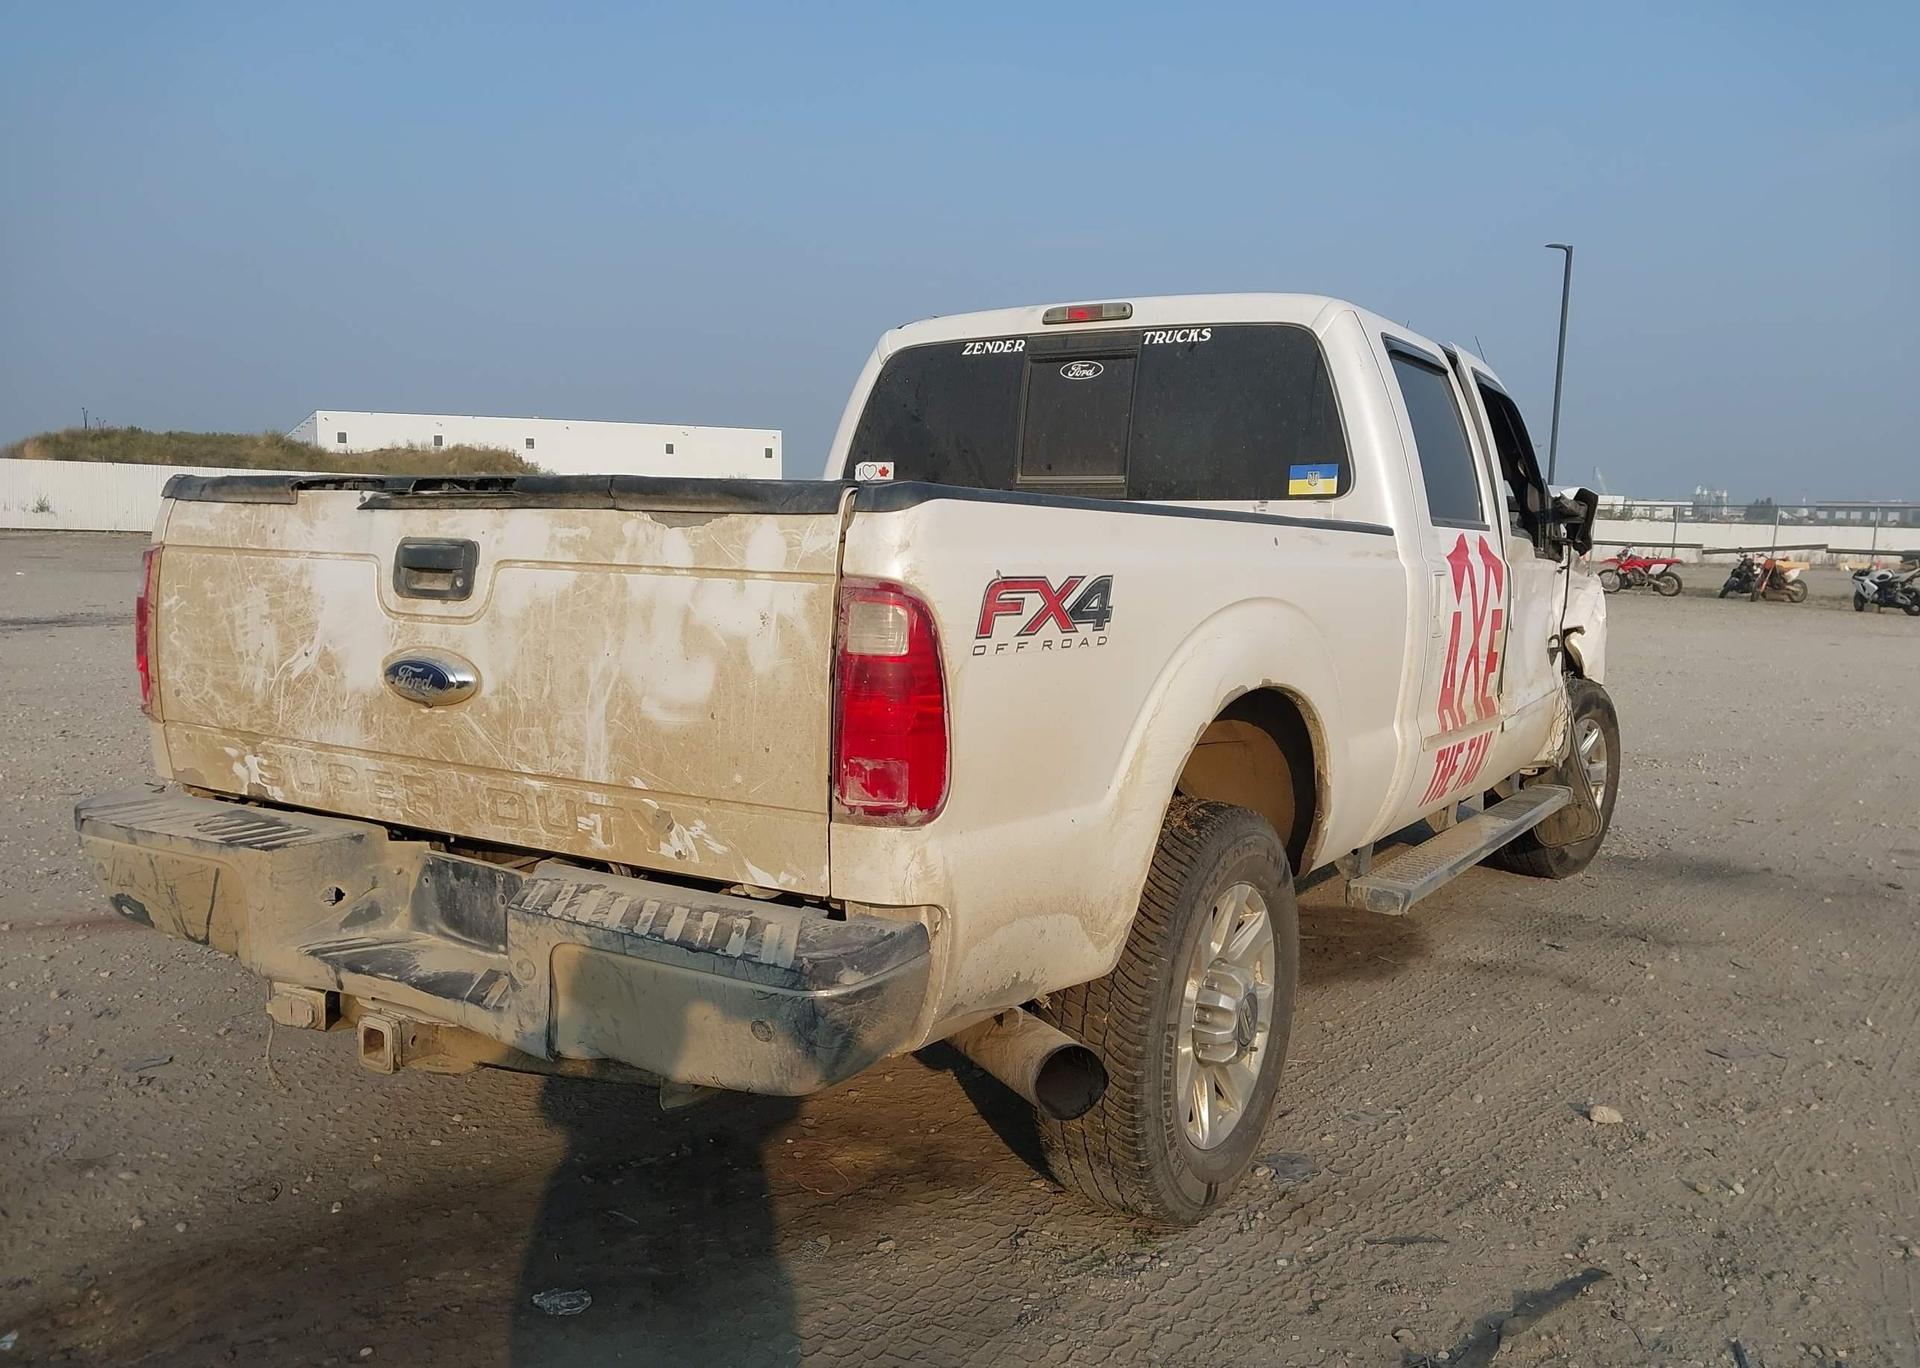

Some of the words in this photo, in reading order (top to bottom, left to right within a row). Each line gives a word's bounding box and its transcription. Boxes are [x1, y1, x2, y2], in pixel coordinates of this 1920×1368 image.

[961, 339, 1026, 356] ZENDER
[1142, 328, 1213, 345] TRUCKS
[1066, 362, 1097, 378] Ford
[975, 574, 1114, 639] FX4
[1438, 533, 1503, 735] AXE
[393, 664, 434, 691] Ford
[972, 641, 1029, 656] OFF
[1041, 636, 1109, 651] ROAD
[1420, 741, 1466, 807] THE
[1451, 730, 1494, 793] TAX
[257, 750, 440, 815] SUPER
[484, 785, 676, 855] DUTY
[1162, 1033, 1178, 1151] MICHELIN
